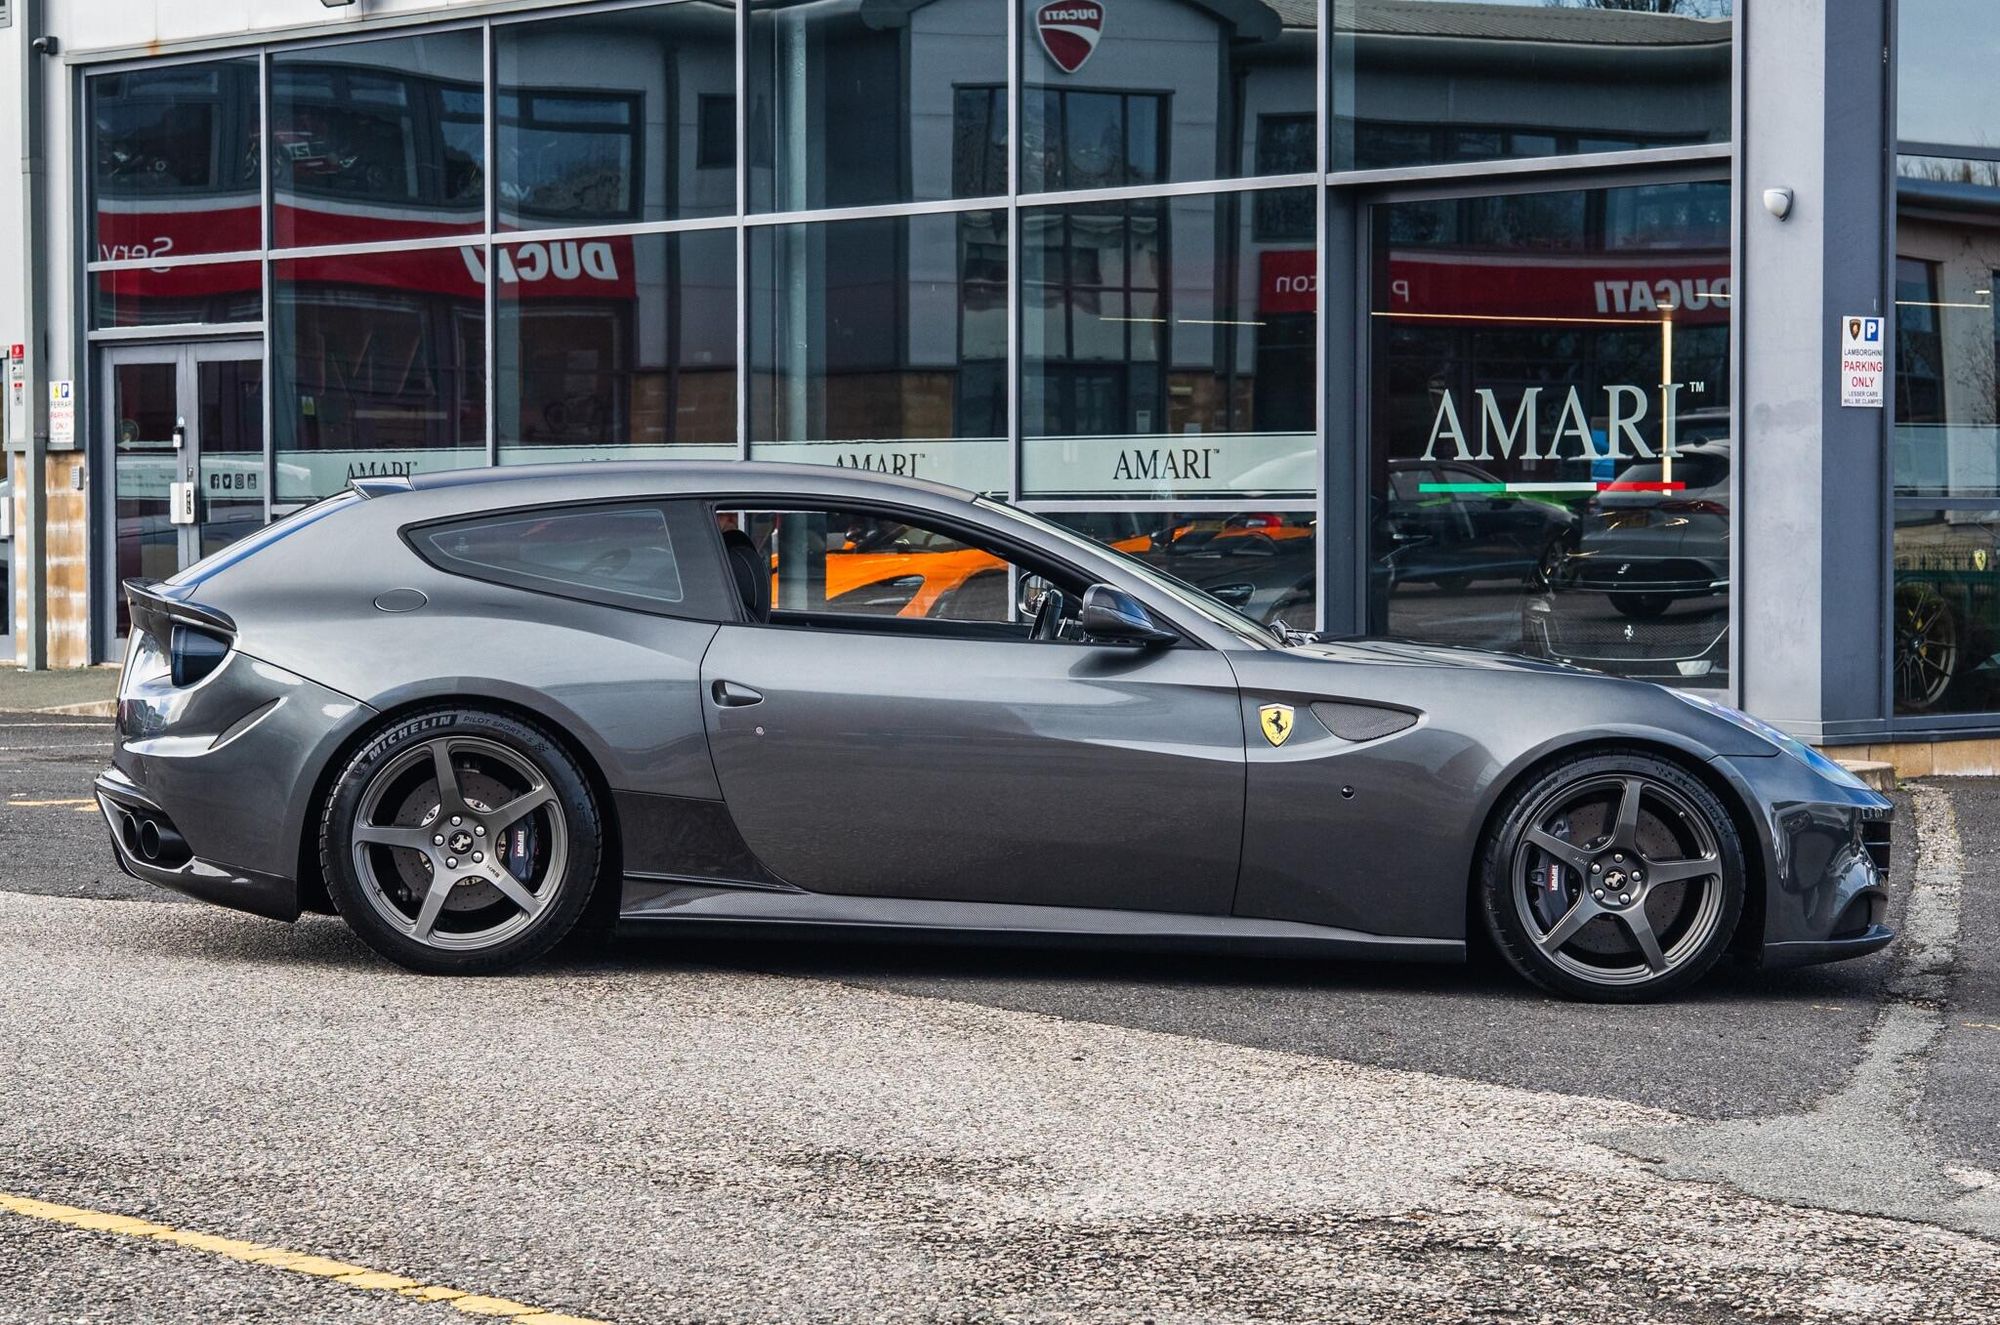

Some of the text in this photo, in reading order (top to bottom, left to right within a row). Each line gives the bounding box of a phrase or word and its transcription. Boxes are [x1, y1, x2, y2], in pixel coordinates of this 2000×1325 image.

[1844, 348, 1882, 356] LAMBORGHINI
[1844, 361, 1883, 372] PARKING
[1851, 376, 1875, 388] ONLY
[1420, 384, 1684, 461] AMARI
[1113, 449, 1212, 480] AMARI
[368, 716, 451, 761] MICHELIN
[464, 715, 490, 724] PILOT
[492, 721, 522, 735] SPORT
